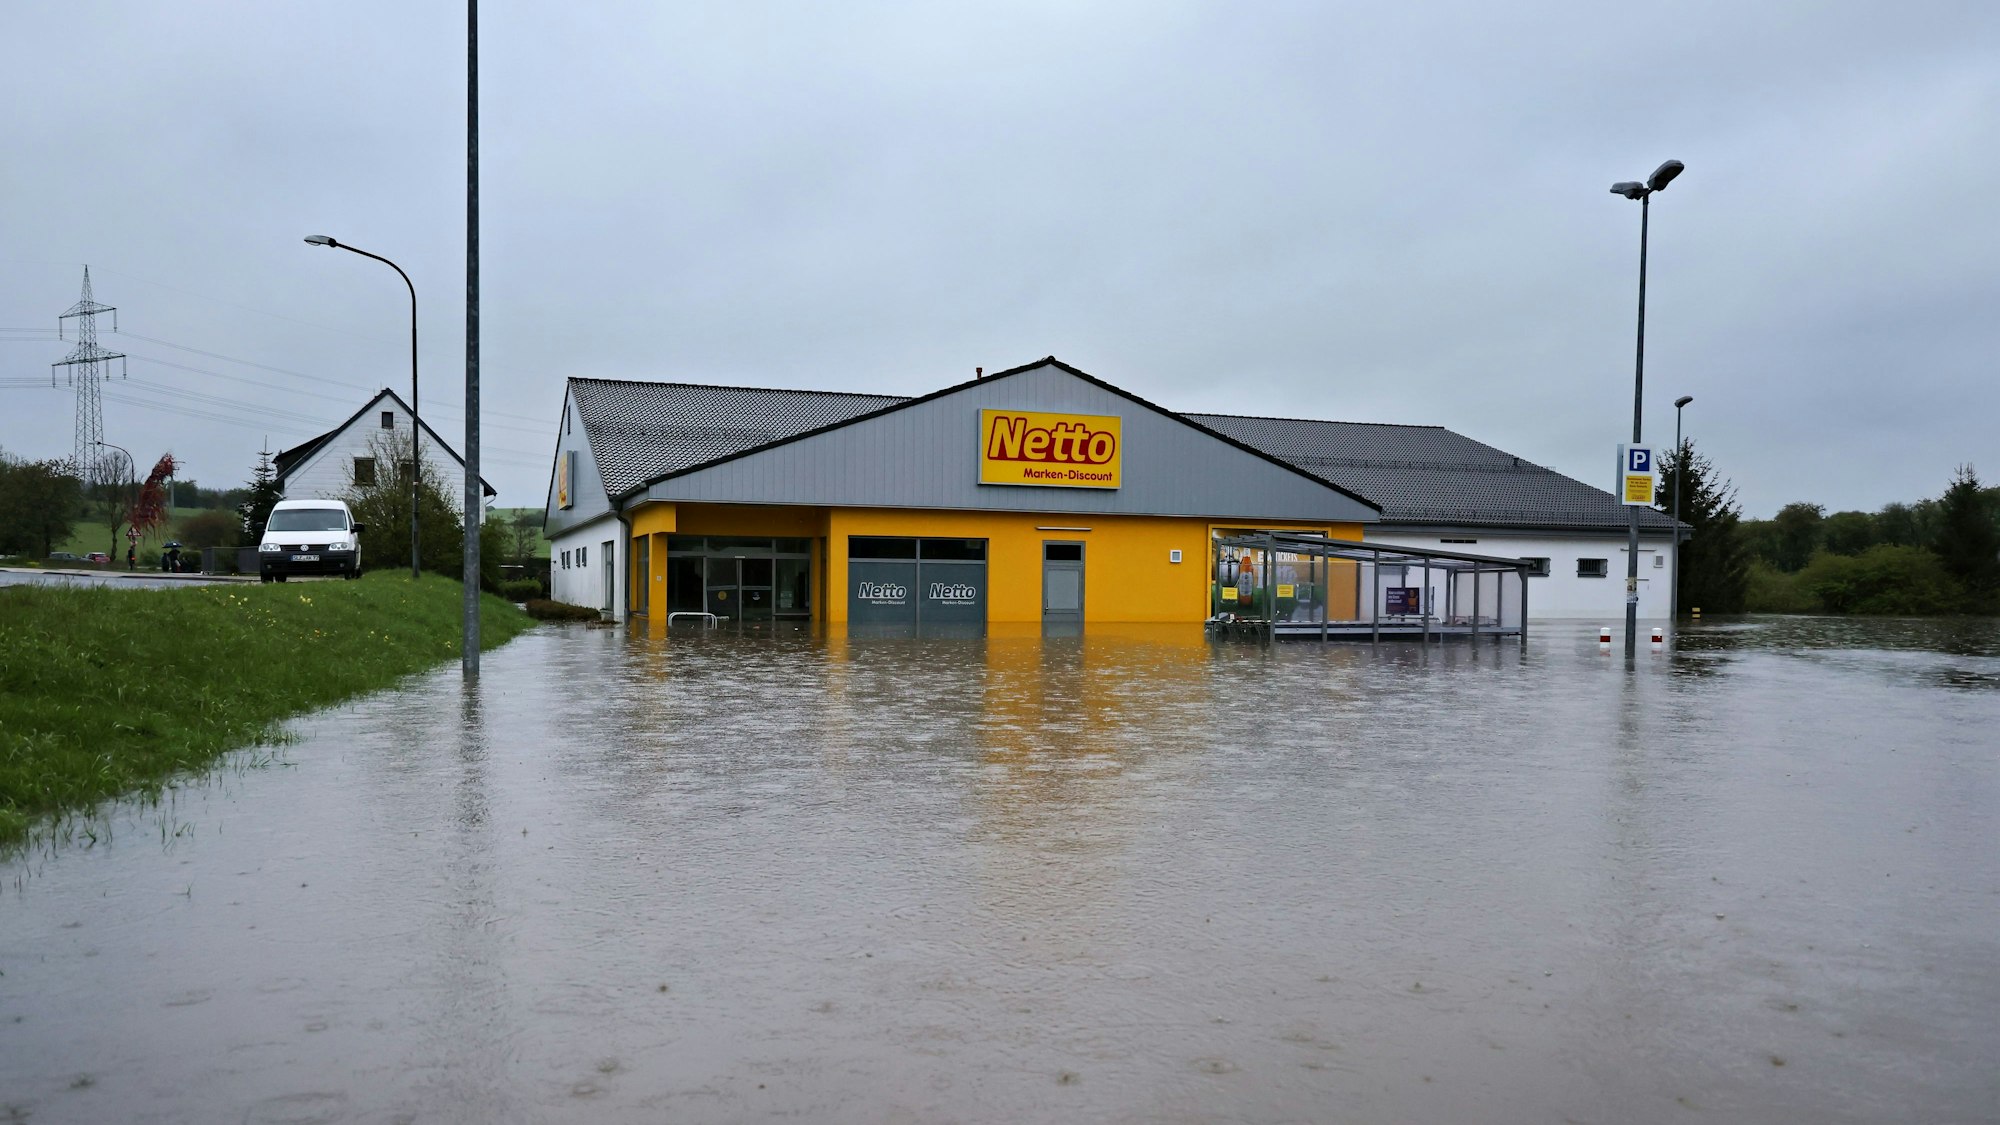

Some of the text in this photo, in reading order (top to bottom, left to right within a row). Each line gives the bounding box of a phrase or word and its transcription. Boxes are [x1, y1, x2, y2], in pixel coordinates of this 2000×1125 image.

[987, 416, 1115, 464] Netto
[1633, 451, 1647, 470] P
[1023, 468, 1113, 481] Marken-Discount
[858, 582, 907, 599] Netto
[929, 583, 976, 599] Netto
